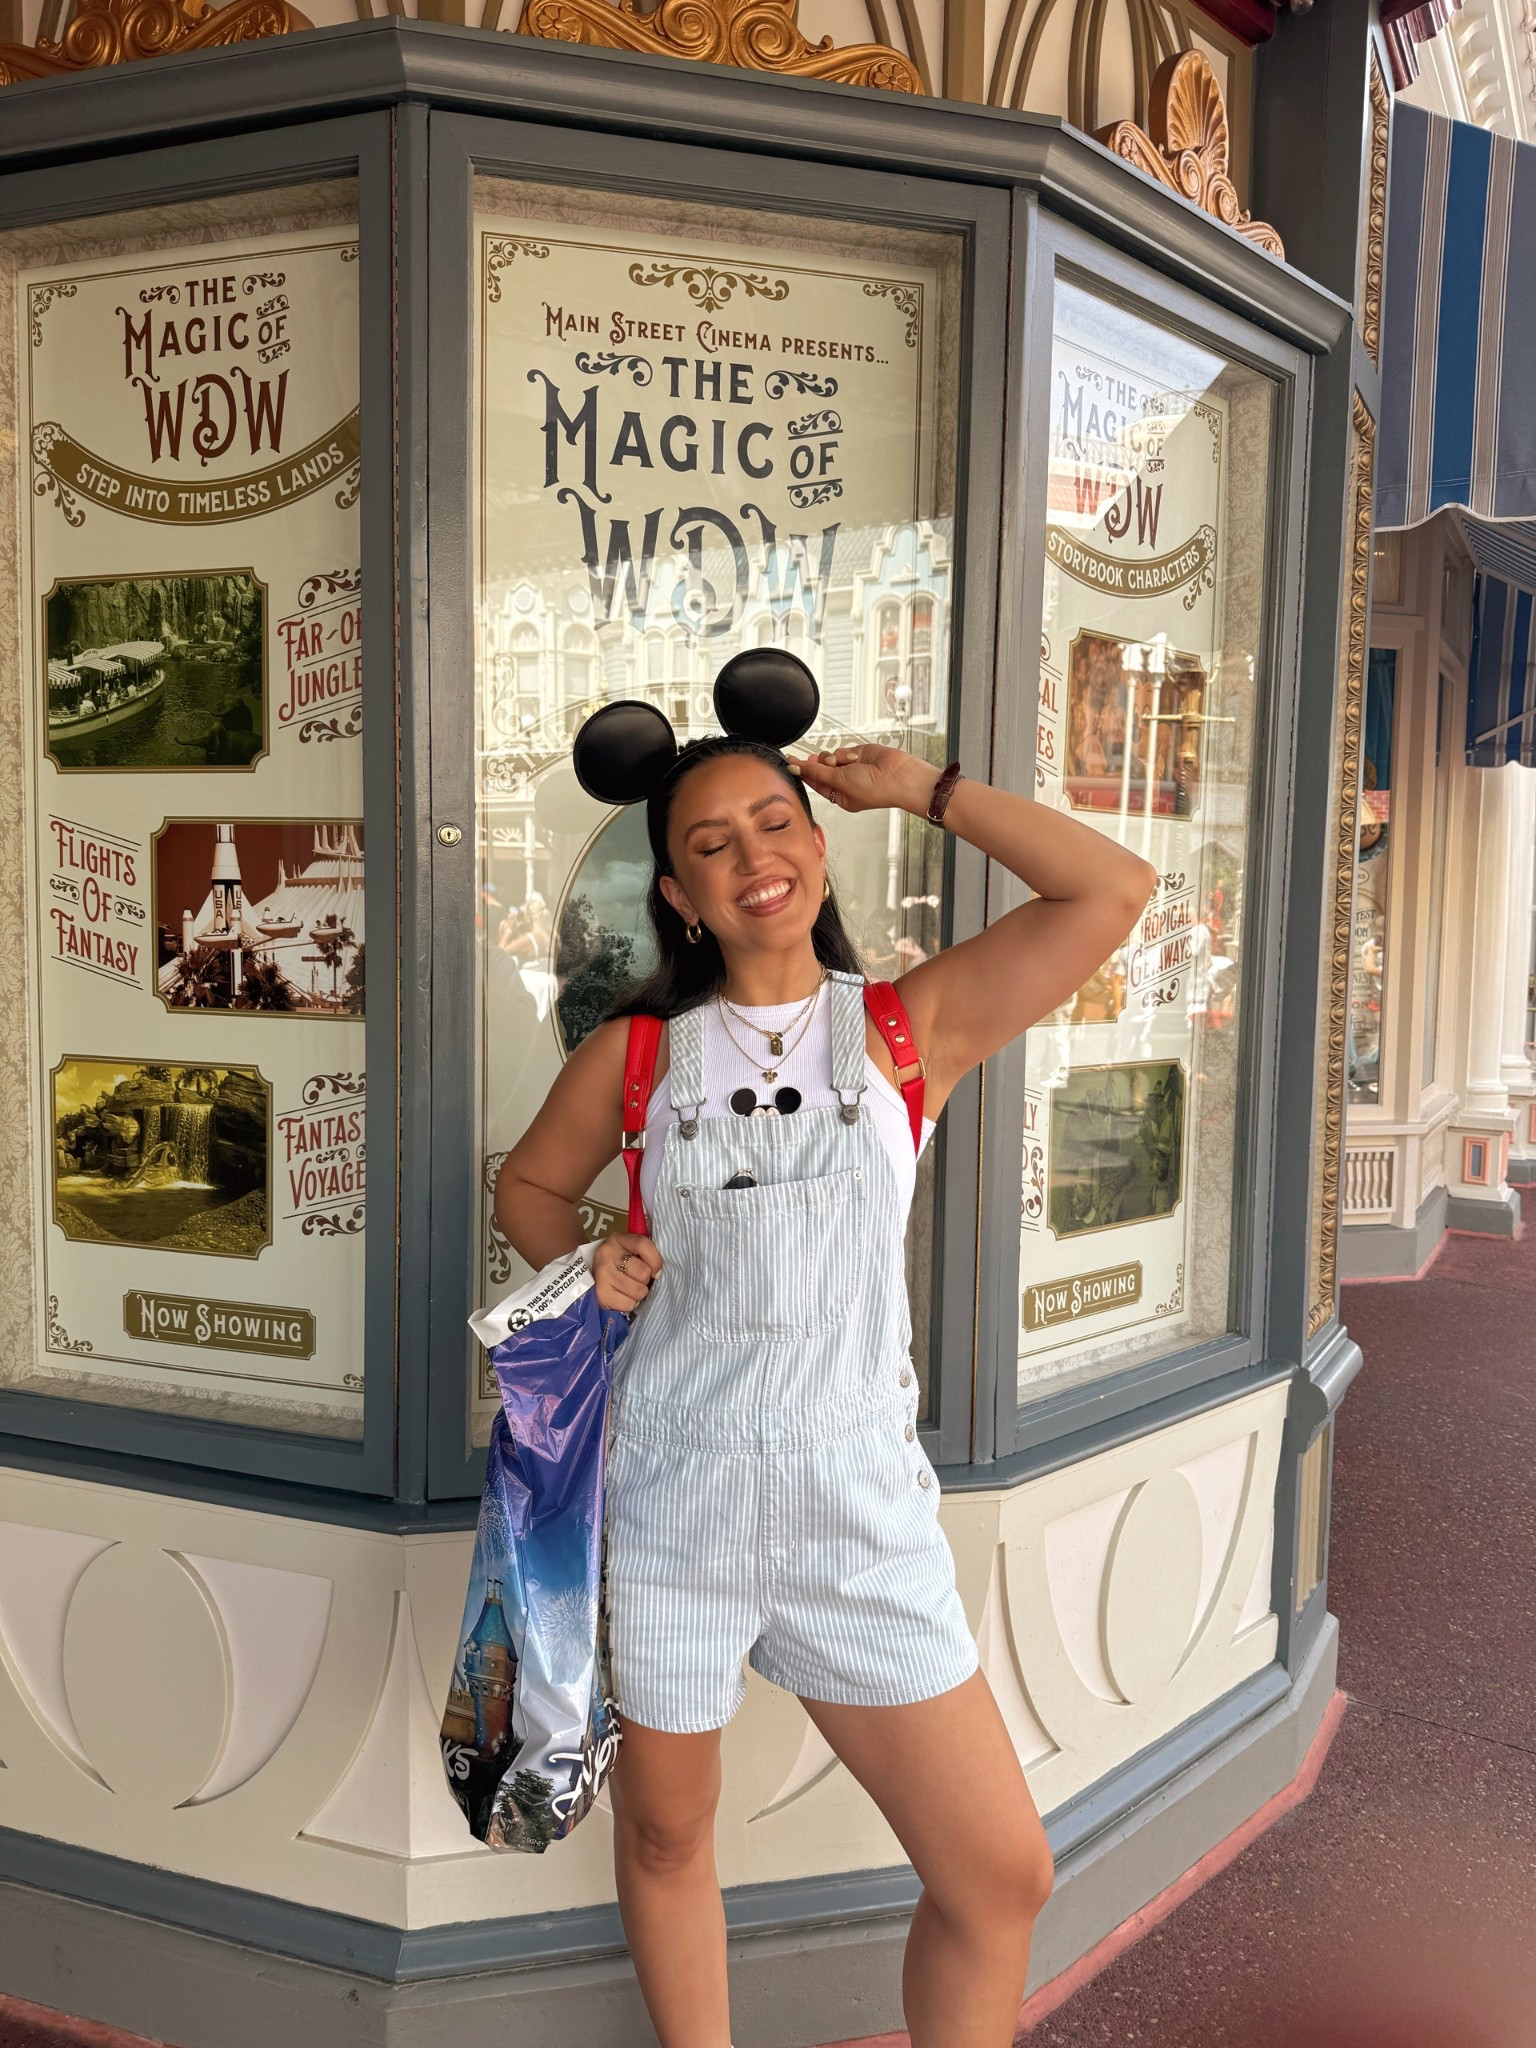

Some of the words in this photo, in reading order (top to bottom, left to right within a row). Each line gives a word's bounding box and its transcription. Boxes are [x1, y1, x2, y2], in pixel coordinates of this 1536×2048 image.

[185, 275, 237, 307] THE
[115, 306, 250, 383] MAGIC
[258, 314, 288, 345] OF
[541, 301, 600, 341] MAIN
[609, 311, 686, 346] STREET
[696, 320, 772, 354] CINEMA
[661, 356, 754, 405] THE
[1105, 375, 1137, 411] THE
[131, 365, 290, 468] WDW
[526, 369, 774, 504] MAGIC
[789, 441, 839, 480] OF
[1058, 370, 1143, 455] MAGIC
[1147, 438, 1164, 456] OF
[76, 463, 121, 499] STEP
[124, 484, 170, 513] INTO
[178, 480, 271, 514] TIMELESS
[276, 442, 344, 496] LANDS
[557, 487, 841, 650] WDW
[1048, 531, 1124, 587] STORYBOOK
[1127, 545, 1200, 589] CHARACTERS
[50, 820, 136, 886] FLIGHTS
[83, 877, 112, 922] OF
[50, 907, 138, 976] FANTASY
[527, 1296, 542, 1309] THIS
[540, 1283, 554, 1297] BAG
[552, 1279, 560, 1287] IS
[559, 1265, 575, 1281] MADE
[535, 1297, 553, 1315] 100%
[551, 1276, 576, 1299] RECYCLED
[1032, 1288, 1068, 1325] NOW
[1070, 1274, 1135, 1317] SHOWING
[137, 1294, 189, 1338] NOW
[194, 1303, 302, 1343] SHOWING
